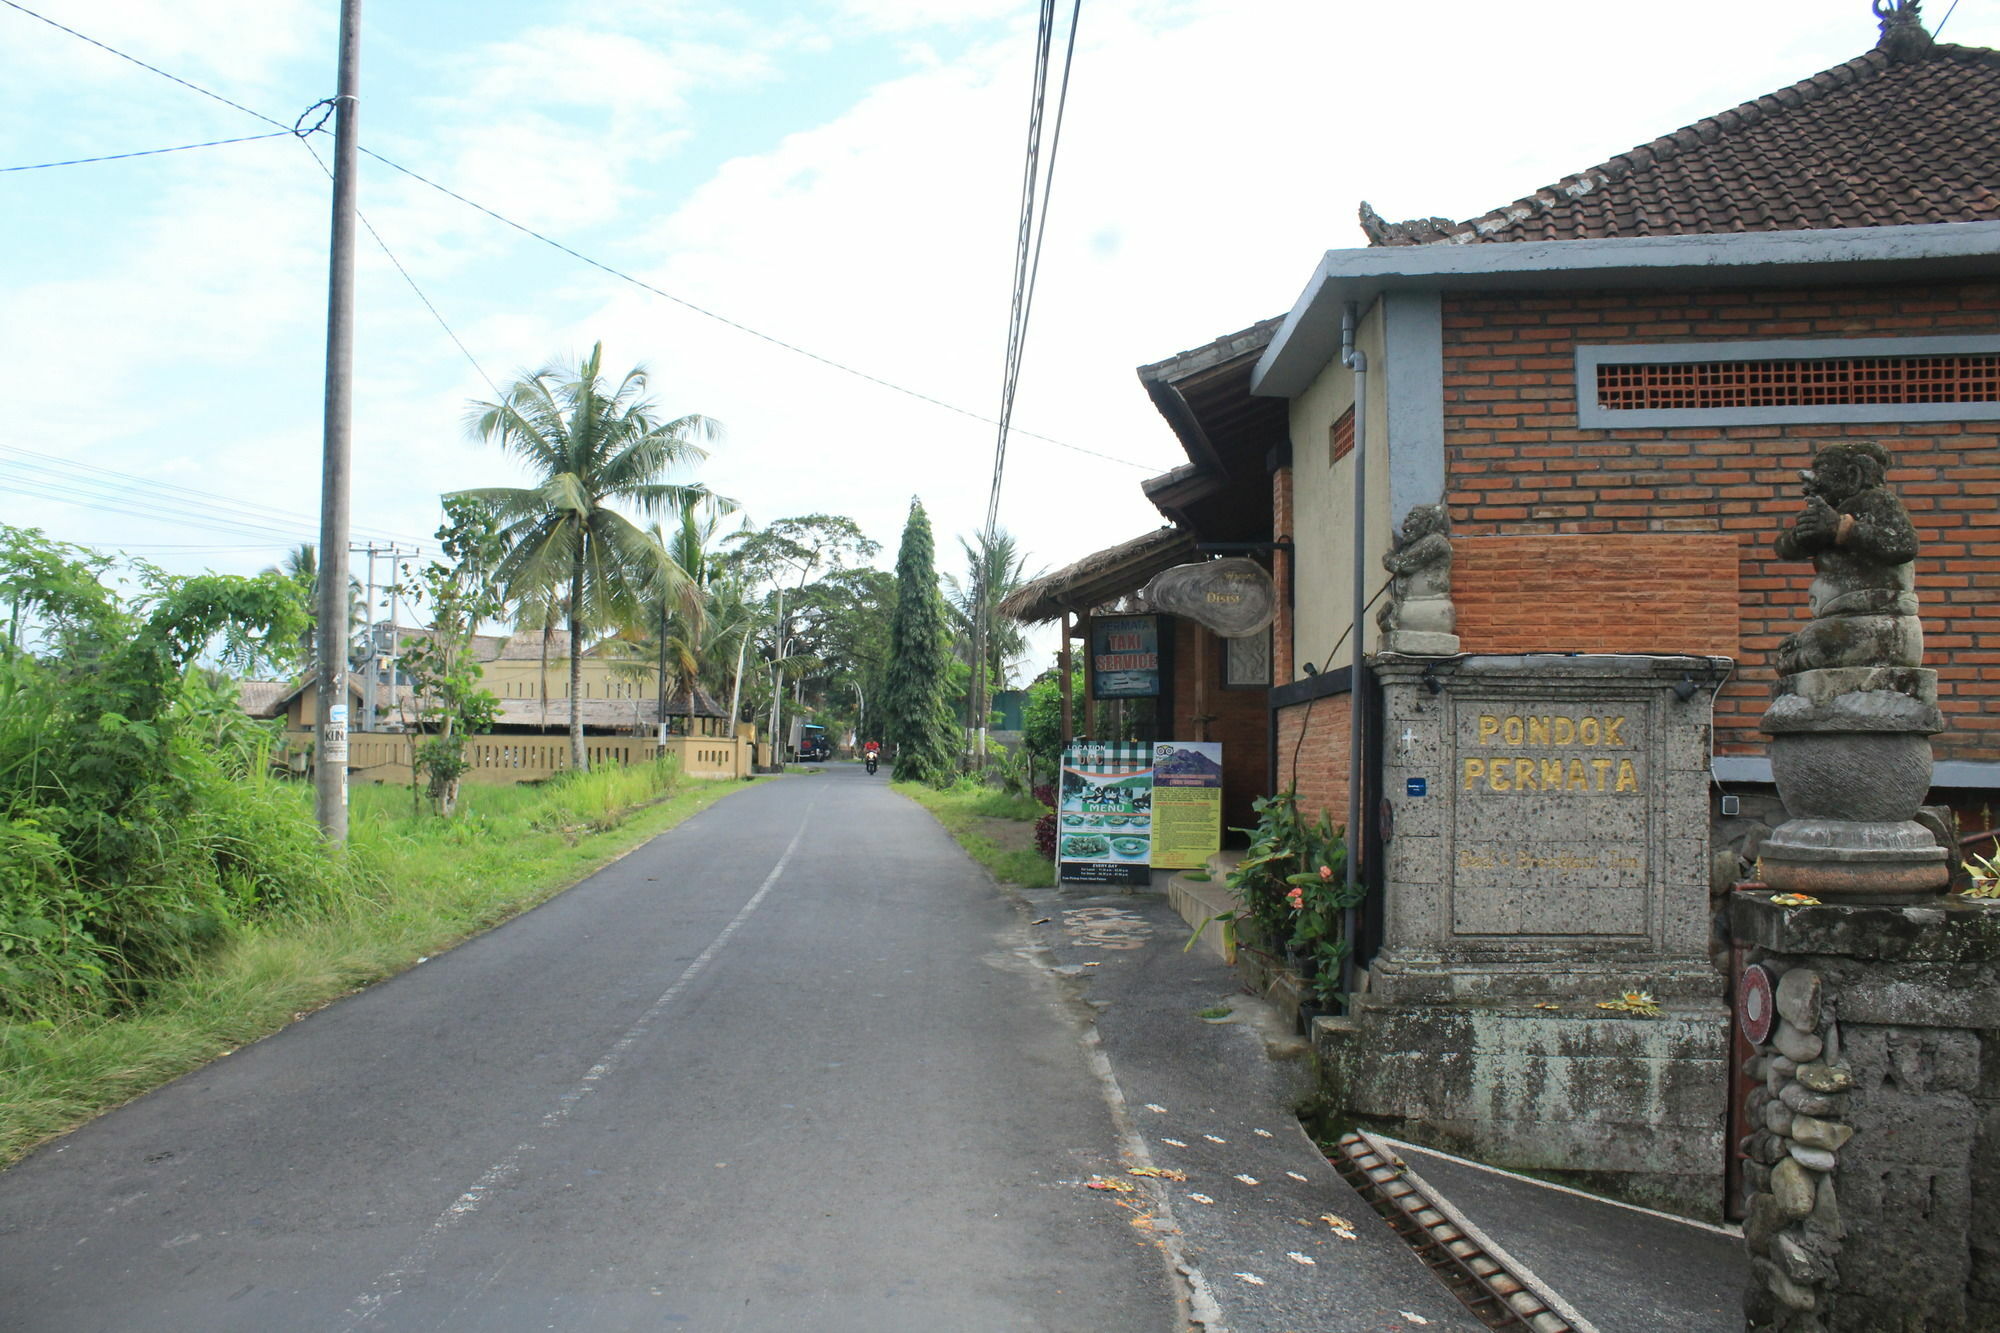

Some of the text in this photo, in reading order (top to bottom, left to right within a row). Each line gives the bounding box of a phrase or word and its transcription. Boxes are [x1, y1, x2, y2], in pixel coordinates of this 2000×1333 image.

[1095, 653, 1157, 672] SERVICE
[1479, 715, 1625, 746] PONDOK
[1067, 744, 1106, 752] LOCATION
[1464, 757, 1639, 792] PERMATA
[1089, 803, 1125, 812] MENU
